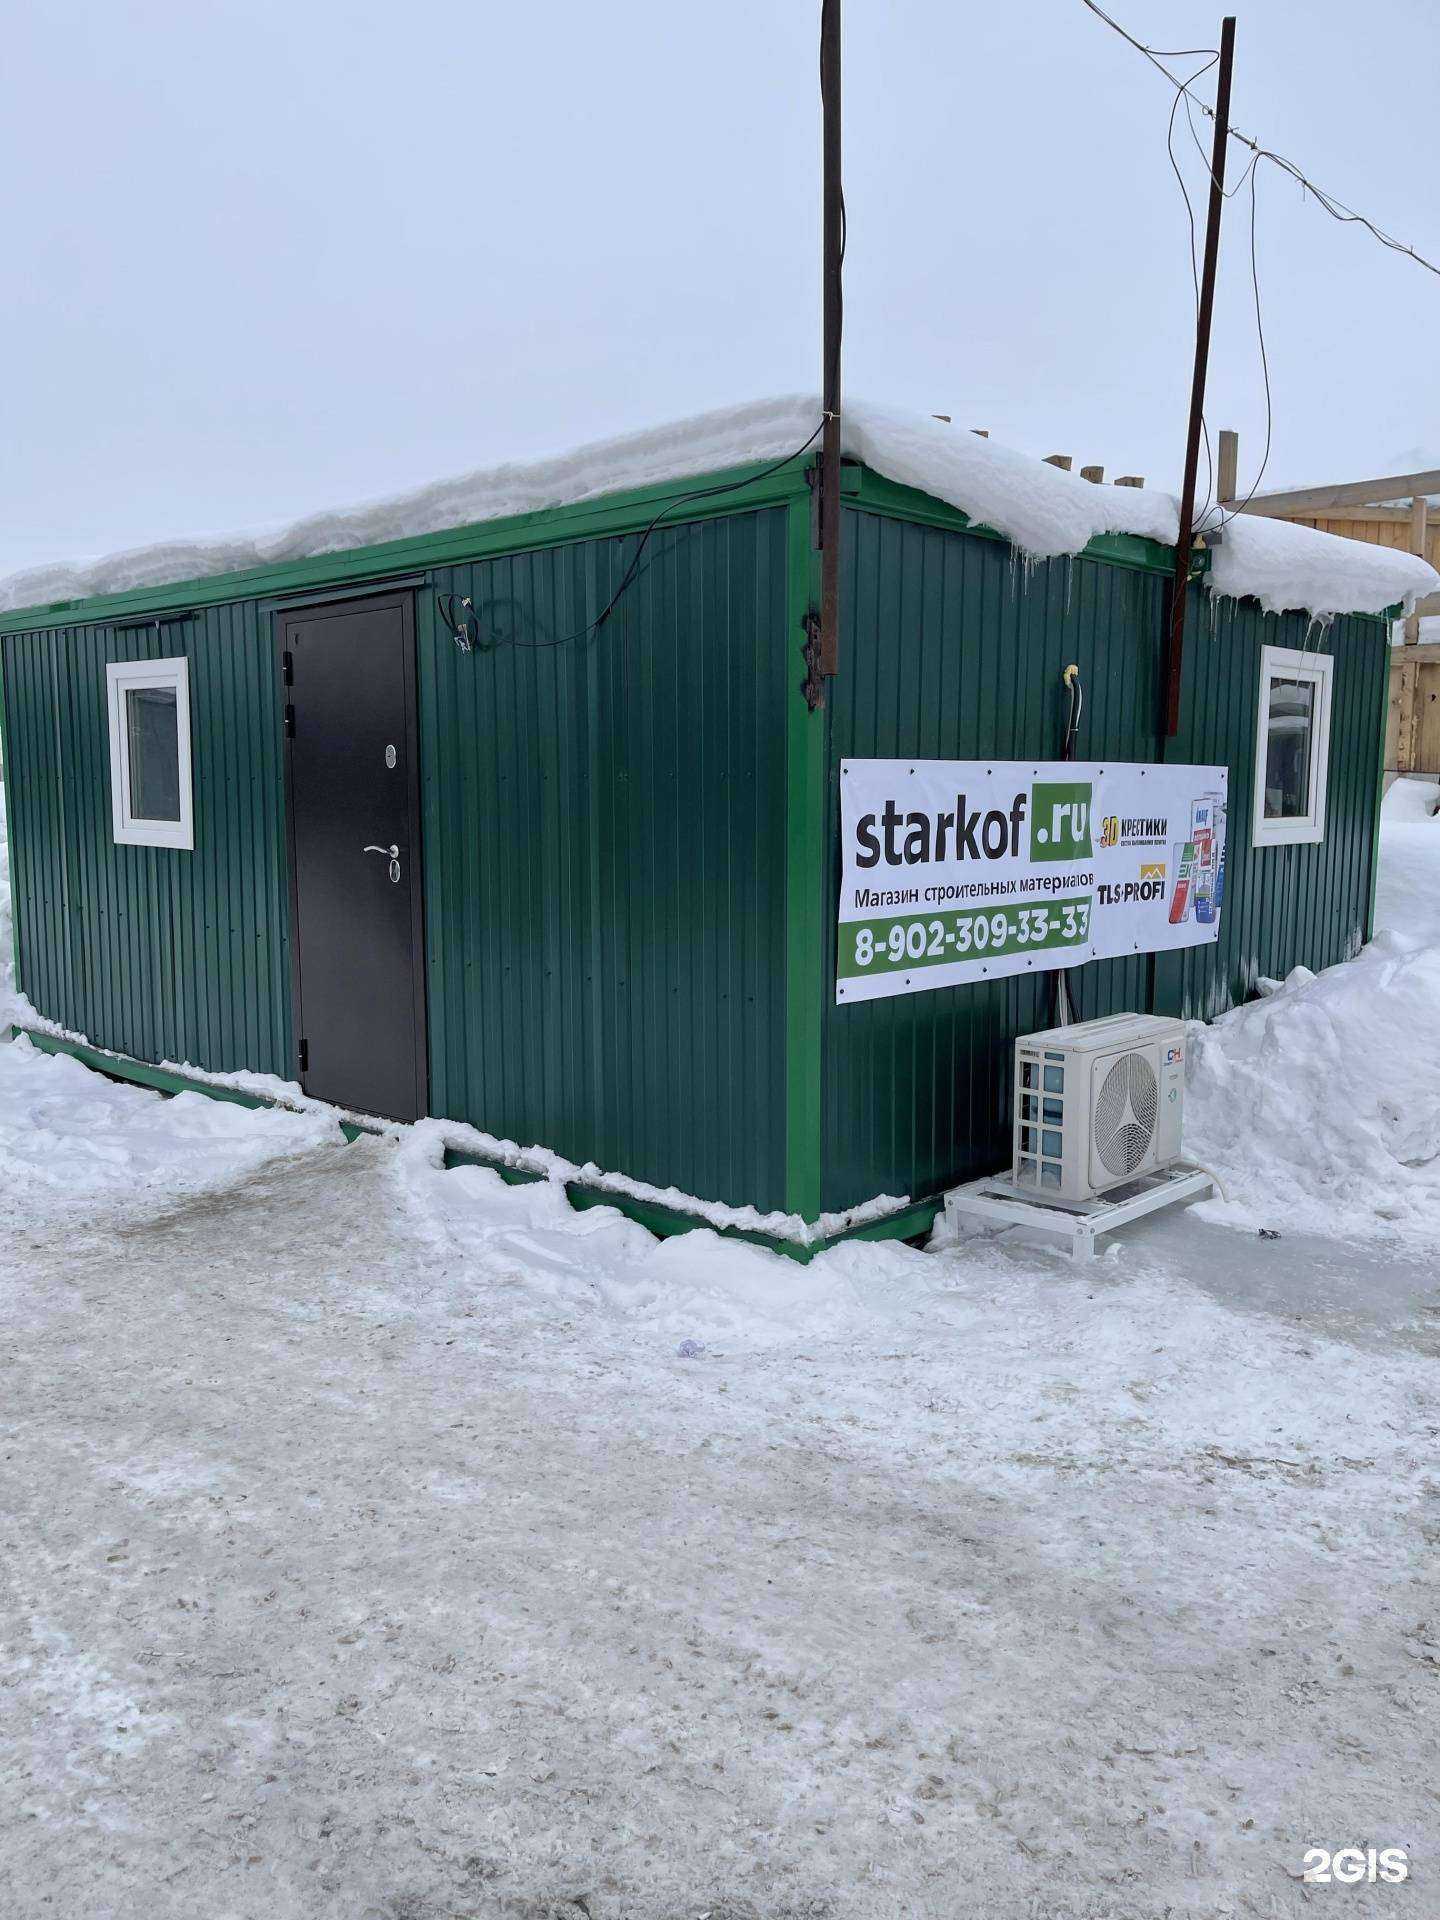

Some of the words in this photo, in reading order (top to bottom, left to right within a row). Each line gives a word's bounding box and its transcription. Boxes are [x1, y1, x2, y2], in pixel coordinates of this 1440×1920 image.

[856, 793, 1087, 868] starkof.ru
[1099, 816, 1119, 848] 3D
[1121, 818, 1167, 837] КРЕСТИКИ
[855, 888, 919, 908] Магазин
[924, 879, 1016, 905] строительных
[1020, 873, 1094, 894] материалов
[854, 904, 1090, 967] 8-902-309-33-33
